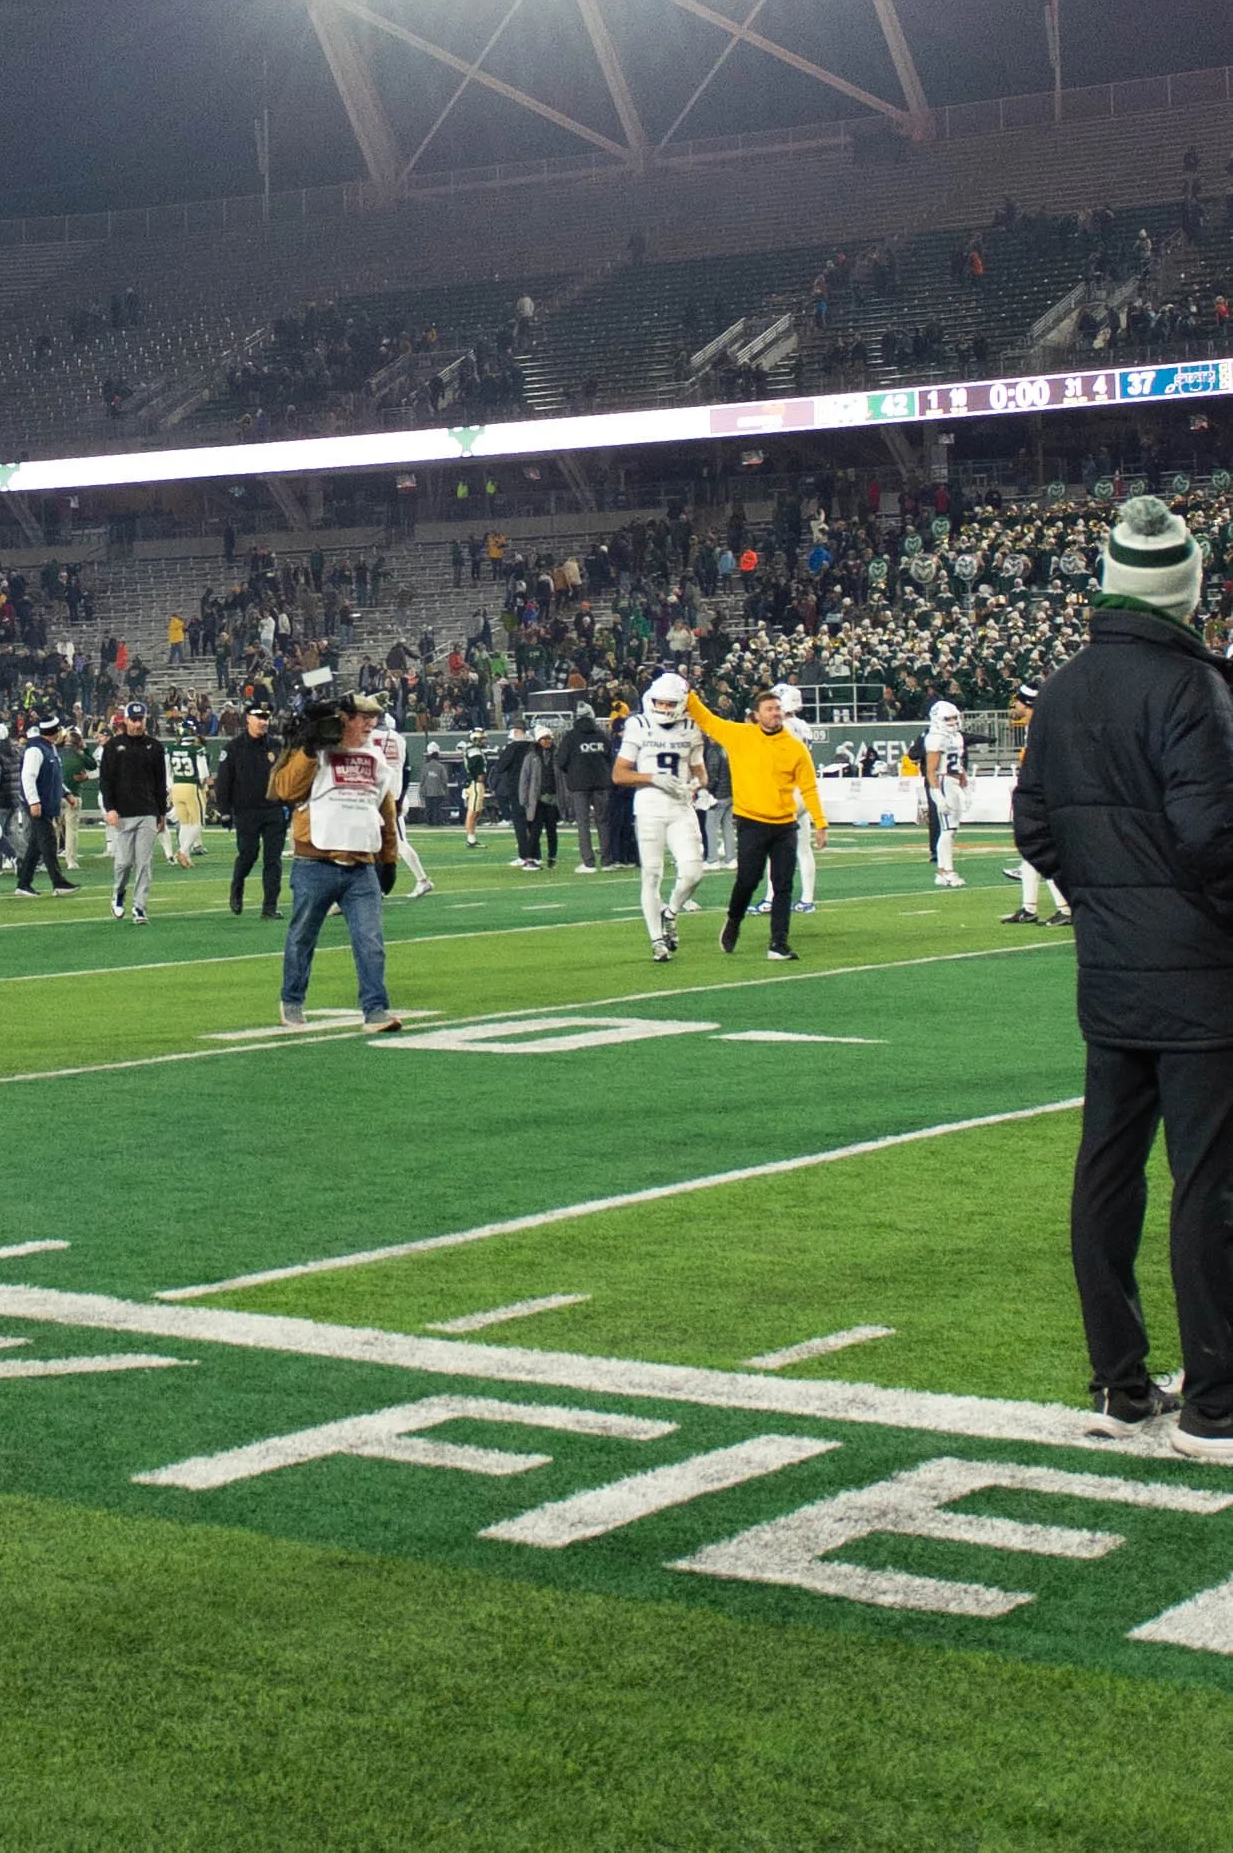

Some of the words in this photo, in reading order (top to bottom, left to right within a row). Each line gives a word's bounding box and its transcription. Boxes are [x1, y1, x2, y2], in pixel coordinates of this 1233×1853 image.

[990, 380, 1051, 410] 0:00
[1127, 371, 1156, 395] 37
[881, 392, 909, 416] 42
[171, 757, 195, 777] 23
[656, 752, 680, 779] 9
